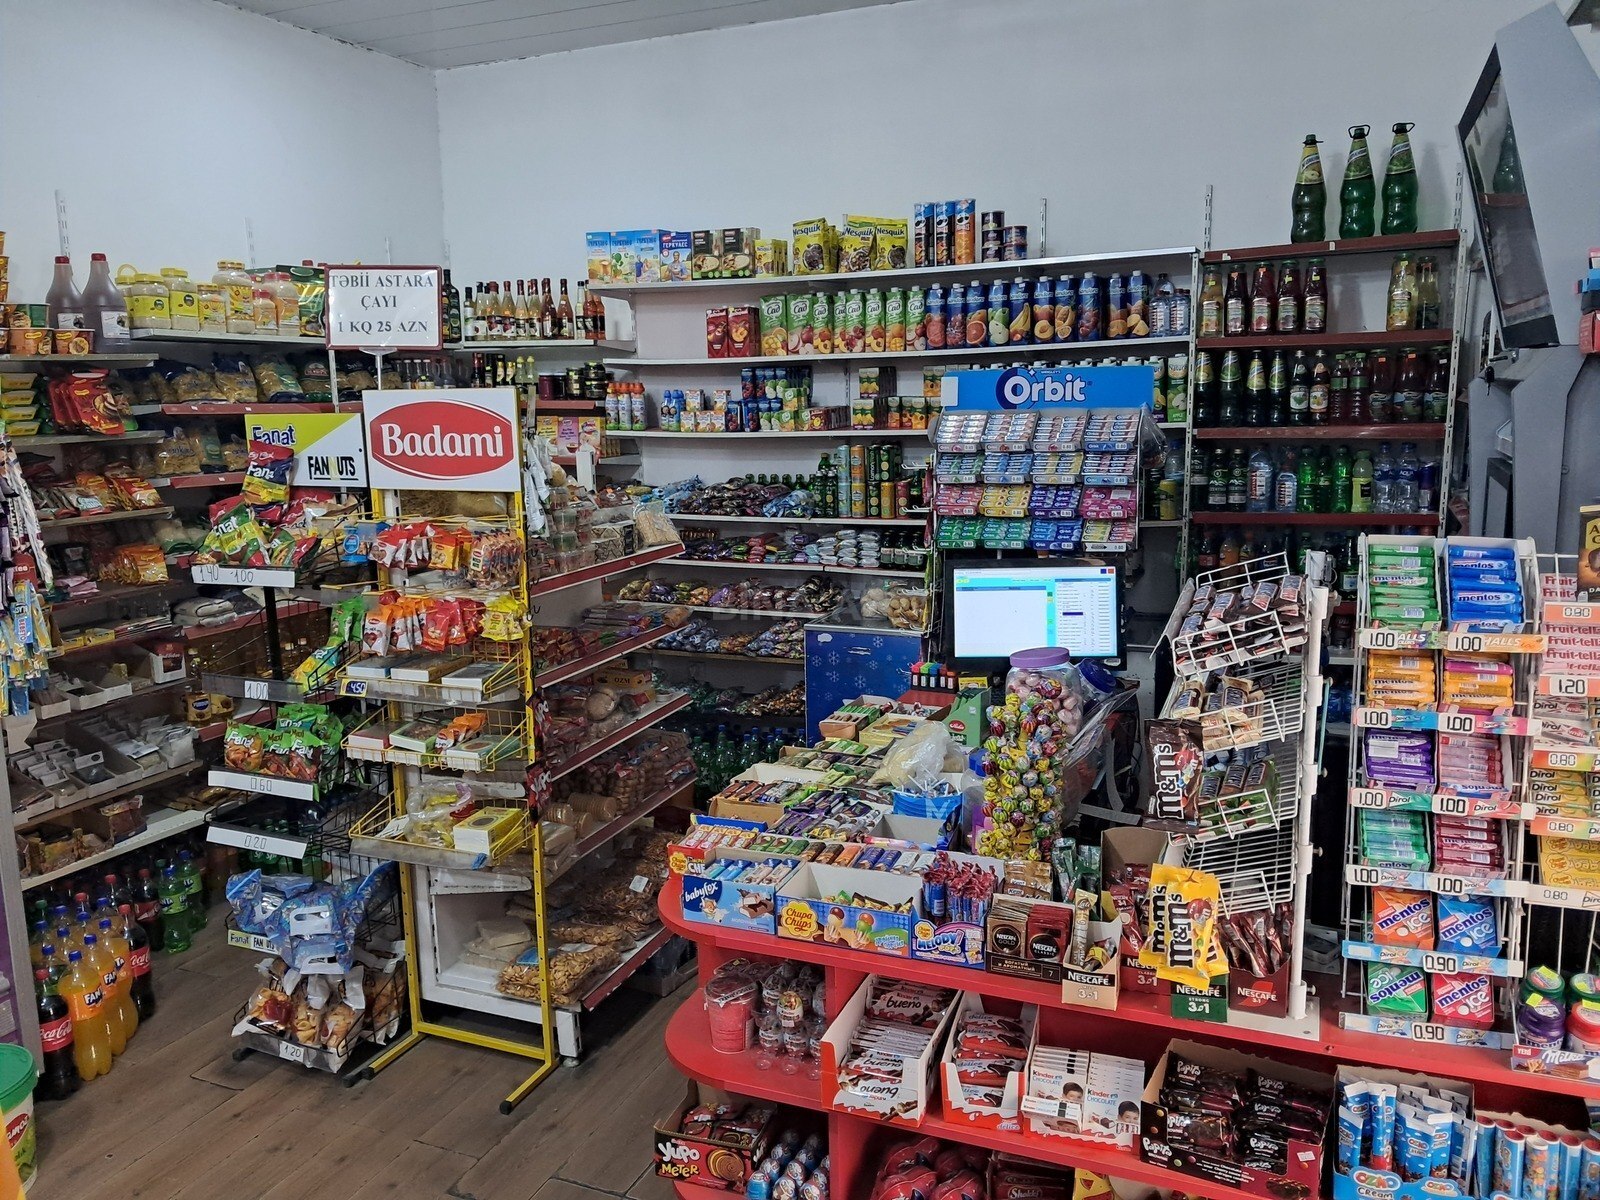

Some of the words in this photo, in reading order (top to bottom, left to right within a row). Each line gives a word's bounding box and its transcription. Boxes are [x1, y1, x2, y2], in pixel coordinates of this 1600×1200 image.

[793, 224, 821, 236] Nesquik
[845, 226, 874, 237] Nesquik
[877, 227, 905, 237] Nesquik
[375, 274, 434, 288] ASTARA
[360, 295, 397, 311] ÇAYI
[350, 321, 372, 335] KQ
[377, 321, 393, 333] 25
[398, 321, 428, 333] AZN
[1003, 372, 1087, 404] Orbit
[252, 425, 296, 446] Fanat
[380, 422, 504, 458] Badami
[1458, 594, 1500, 602] mentos
[1369, 632, 1395, 647] 1.00
[1455, 636, 1482, 652] 1.00
[1548, 635, 1600, 647] Fruit-tell
[1557, 679, 1585, 695] 1.20
[1533, 702, 1558, 711] Dirol
[1364, 711, 1389, 726] 1.00
[1446, 715, 1473, 732] 1.00
[1529, 770, 1556, 779] Dirol
[1531, 783, 1558, 792] Dirol
[1358, 792, 1384, 806] 1.00
[1388, 796, 1411, 804] Dirol
[1535, 793, 1562, 802] Dirol
[1440, 798, 1466, 814] 1.00
[1473, 804, 1498, 812] Dirol
[1378, 861, 1410, 869] entos
[1354, 868, 1379, 884] 1.00
[685, 881, 719, 902] babyfox
[1437, 878, 1463, 893] 1.00
[785, 908, 813, 920] Chupa
[1378, 898, 1431, 930] mentos
[784, 916, 813, 931] Chups
[1440, 907, 1493, 940] mentos
[917, 932, 957, 950] MELODY
[1425, 954, 1457, 973] 0.90
[1067, 971, 1111, 986] NESCAFÉ
[1369, 971, 1422, 1003] mentos
[1436, 976, 1489, 1008] mentos
[886, 996, 922, 1009] bueno
[1413, 1024, 1445, 1041] 0.90
[863, 1058, 902, 1069] bueno
[1541, 1049, 1586, 1064] Milka
[1032, 1076, 1062, 1087] CHOCOLATE
[860, 1084, 900, 1099] bueno
[1087, 1095, 1117, 1107] CHOCOLATE
[1142, 1137, 1173, 1157] Papita
